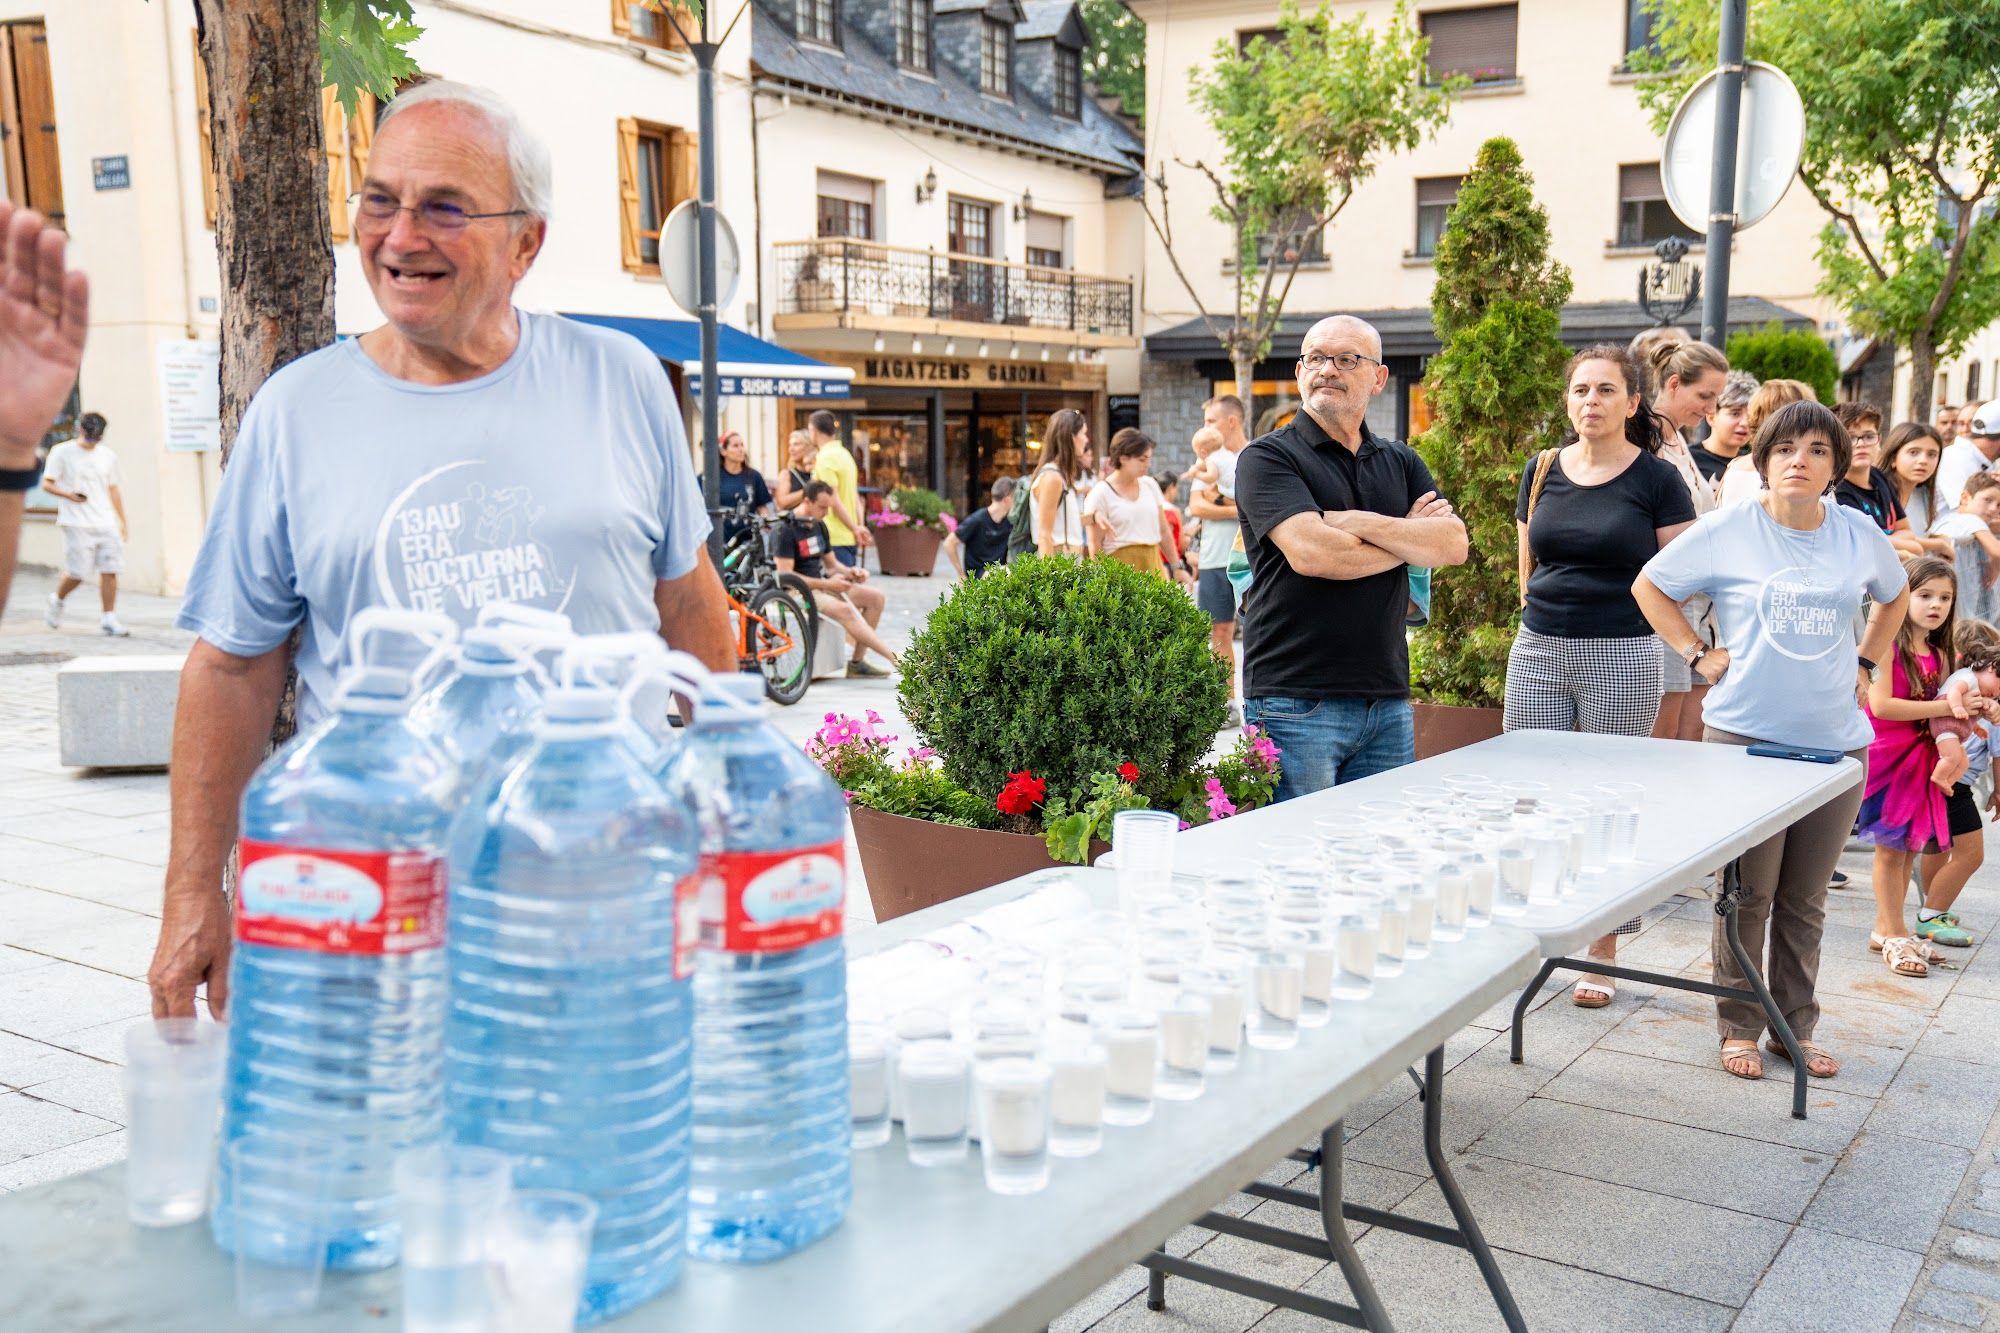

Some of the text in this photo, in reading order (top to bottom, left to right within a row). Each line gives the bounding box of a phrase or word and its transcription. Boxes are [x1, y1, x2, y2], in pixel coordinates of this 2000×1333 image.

[865, 359, 1047, 383] MAGATZEMS GARONA
[396, 502, 461, 536] 13AU
[399, 532, 454, 564] ERA
[404, 543, 543, 591] NOCTURNA
[409, 570, 548, 615] DE VIELHA
[1771, 592, 1797, 606] ERA
[1770, 606, 1837, 622] NOCTURNA
[1770, 620, 1834, 636] DE VIELHA
